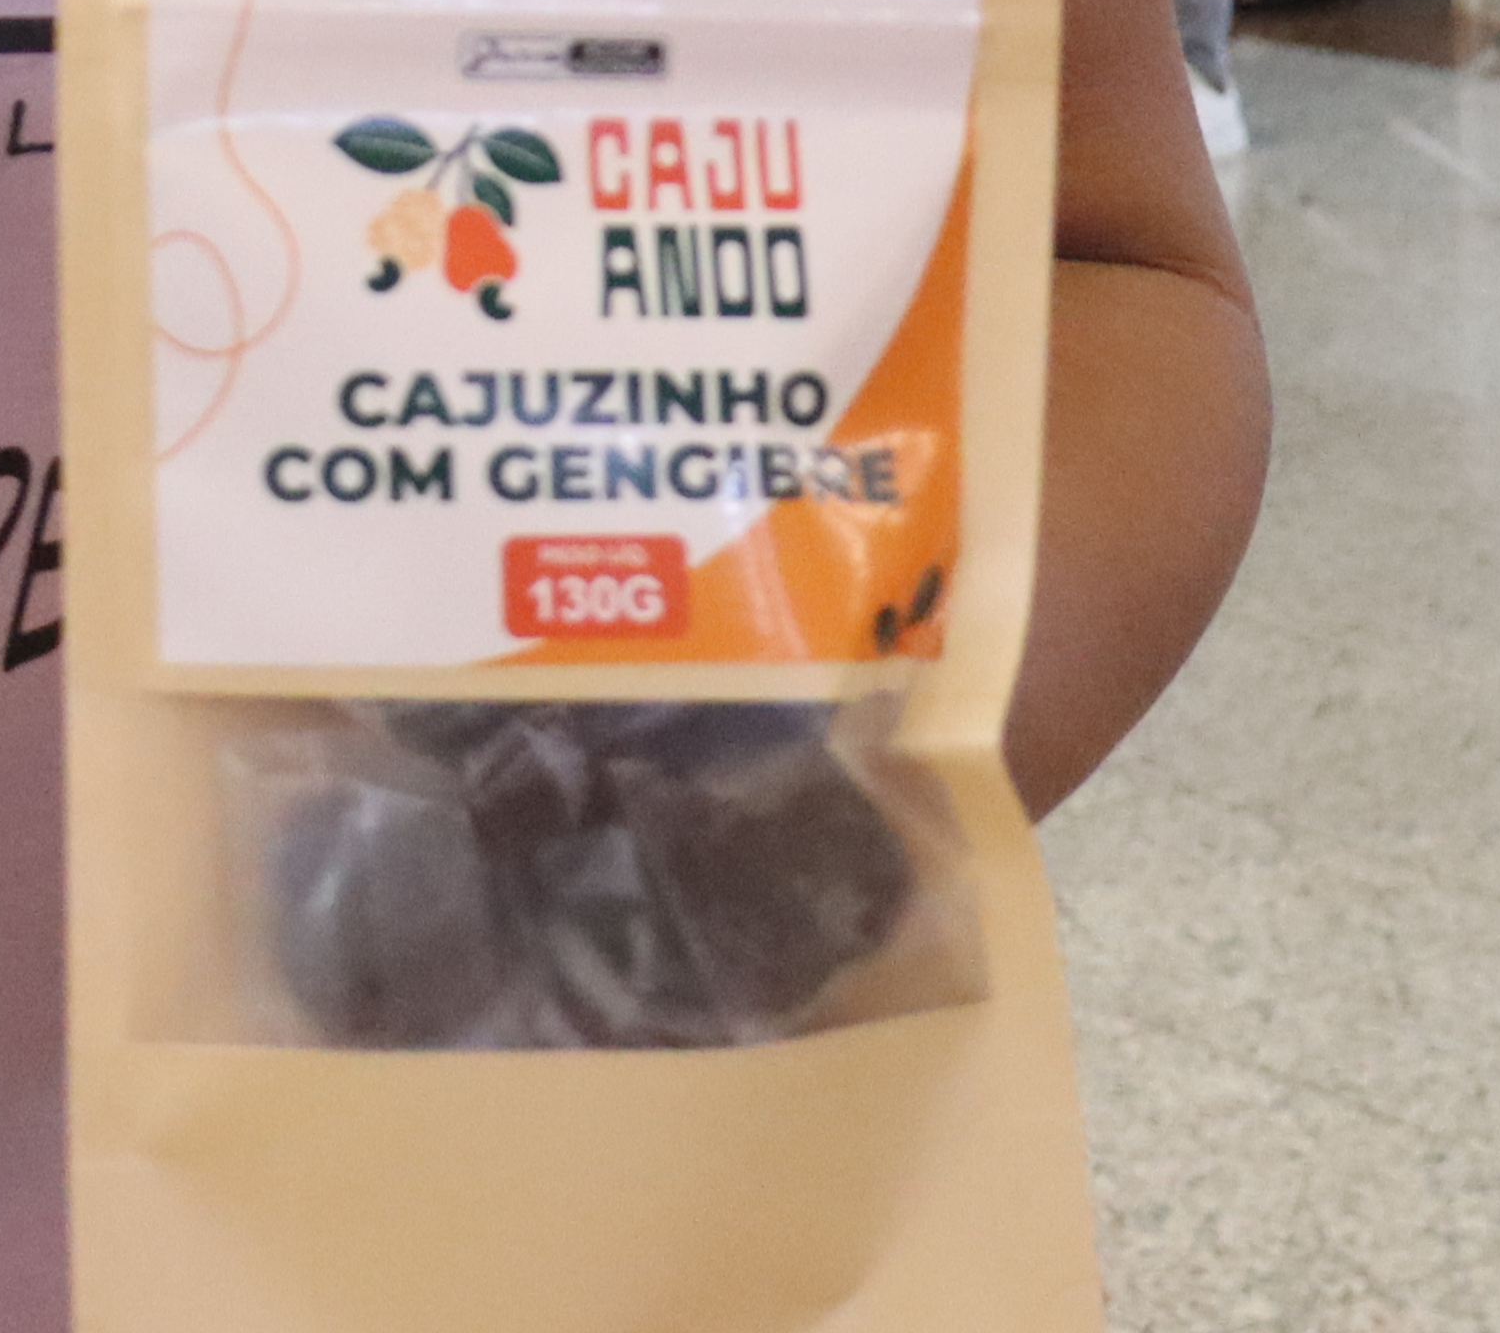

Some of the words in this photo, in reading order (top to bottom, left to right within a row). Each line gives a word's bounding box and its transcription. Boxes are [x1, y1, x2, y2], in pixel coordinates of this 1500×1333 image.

[588, 117, 803, 210] CAJU
[602, 224, 808, 318] ANDO
[337, 370, 828, 429] CAJUZINHO
[262, 445, 455, 503] COM
[487, 444, 901, 505] GENGIBRE
[529, 573, 666, 623] 130G
